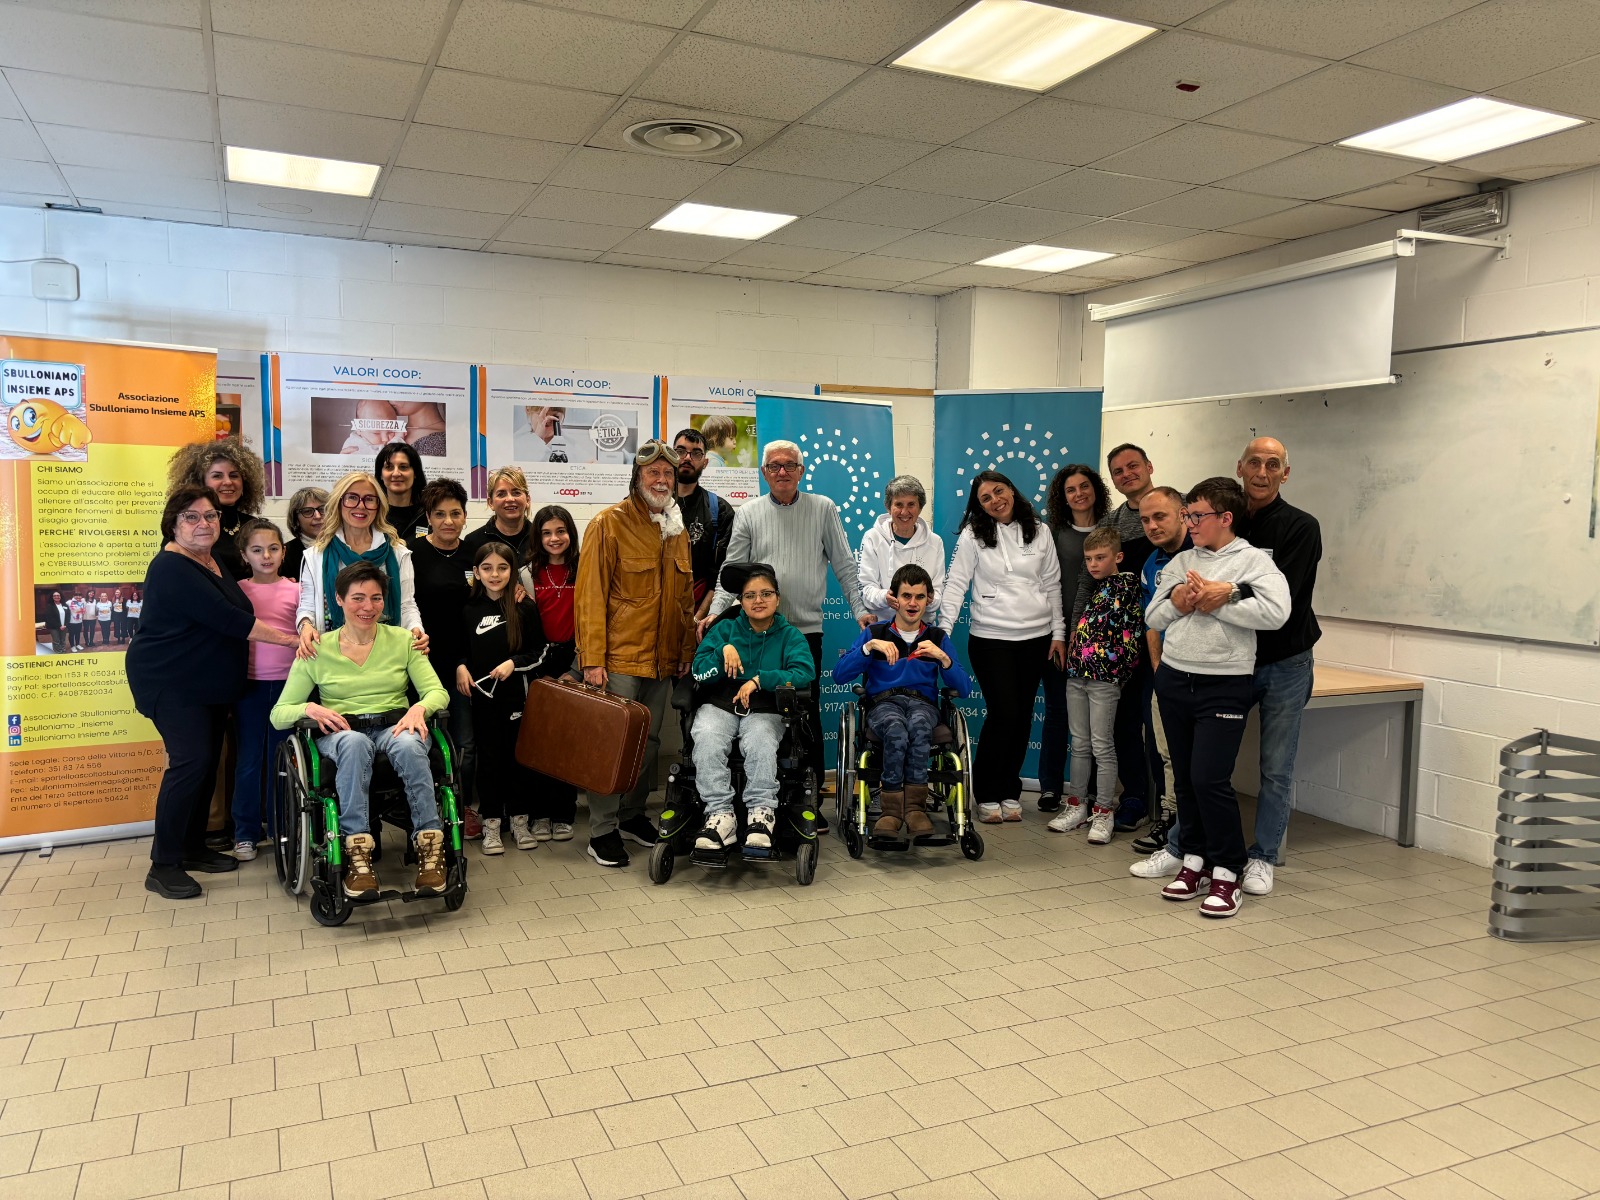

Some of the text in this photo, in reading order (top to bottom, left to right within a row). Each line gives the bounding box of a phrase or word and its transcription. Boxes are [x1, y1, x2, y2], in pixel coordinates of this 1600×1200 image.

[3, 368, 78, 382] SBULLONIAMO
[333, 365, 422, 380] VALORI COOP:
[533, 376, 611, 390] VALORI COOP:
[7, 384, 75, 397] INSIEME APS
[708, 386, 744, 397] VALORI
[118, 392, 180, 404] Associazione
[89, 404, 206, 418] Sbulloniamo Insieme APS
[358, 420, 400, 430] SICUREZZA
[597, 427, 622, 438] ETICA
[37, 466, 83, 474] CHI SIAMO
[66, 478, 128, 487] un'associazione
[38, 489, 69, 497] occupa
[134, 490, 163, 498] legalità
[38, 517, 68, 525] disagio
[106, 541, 133, 550] aperta
[57, 551, 104, 559] presentano
[106, 550, 141, 558] problemi
[94, 569, 125, 578] rispetto
[126, 568, 146, 576] della
[480, 614, 501, 626] NIKE
[6, 660, 54, 670] SOSTIENICI
[56, 658, 85, 667] ANCHE
[6, 674, 42, 682] Bonifico:
[8, 684, 22, 692] Pay
[23, 712, 78, 722] Associazione
[80, 708, 130, 717] Sbulloniamo
[23, 722, 75, 732] sbulloniamo
[23, 733, 76, 743] Sbulloniamo
[78, 730, 110, 738] Insieme
[32, 758, 60, 766] Legale:
[88, 753, 107, 761] della
[108, 751, 136, 760] Vittoria
[10, 768, 46, 776] Telefono:
[10, 776, 39, 784] E-mail:
[10, 795, 28, 803] Ente
[30, 793, 42, 801] del
[44, 792, 65, 800] Terzo
[67, 789, 95, 798] Settore
[20, 802, 52, 812] numero
[64, 796, 103, 808] Repertorio
